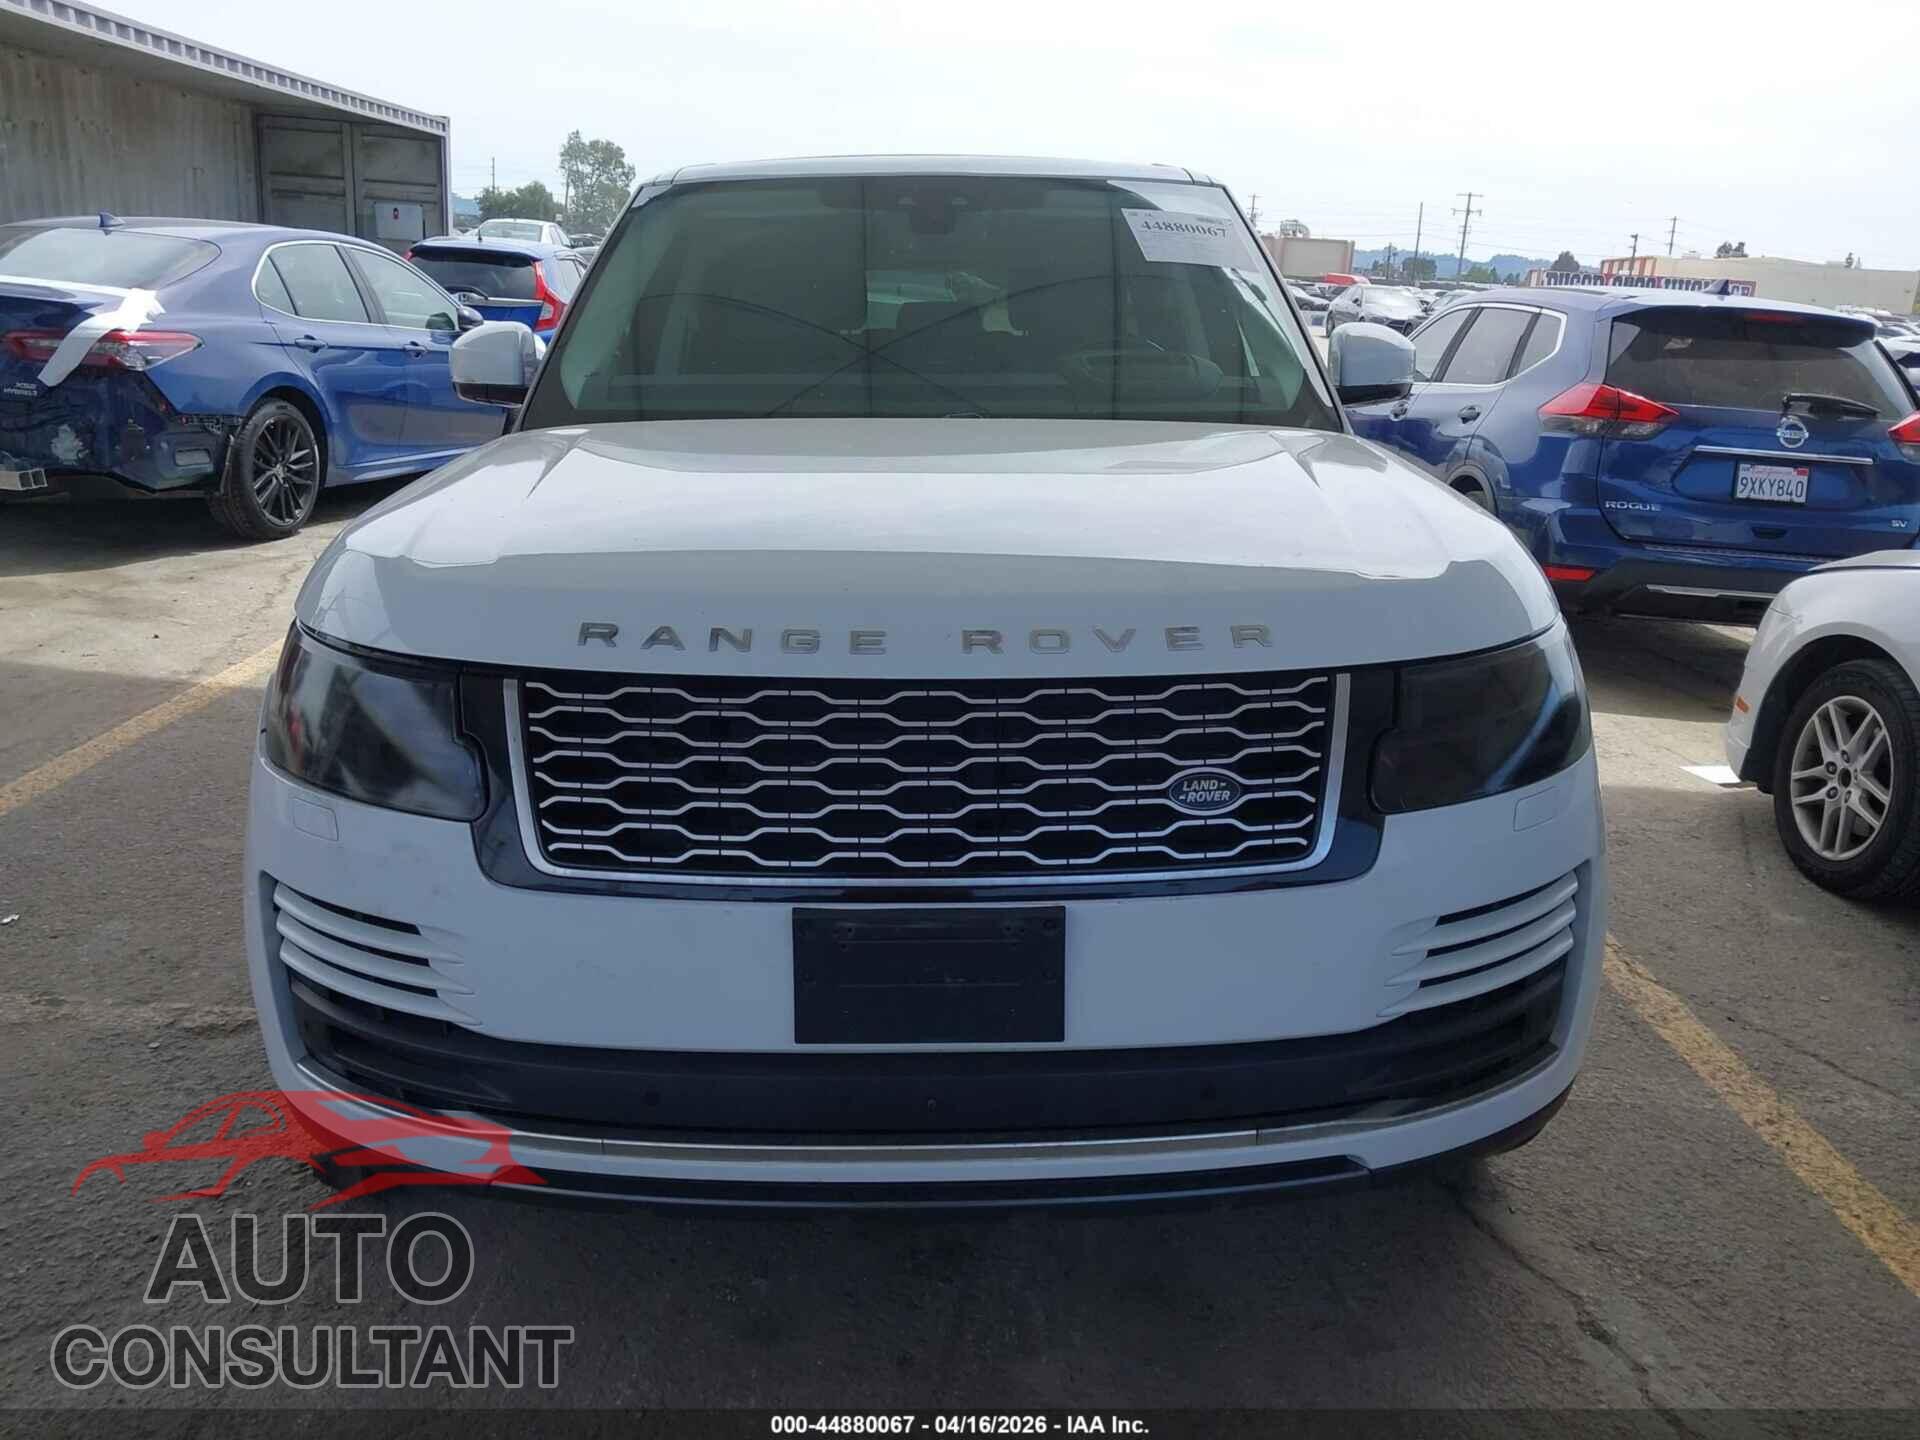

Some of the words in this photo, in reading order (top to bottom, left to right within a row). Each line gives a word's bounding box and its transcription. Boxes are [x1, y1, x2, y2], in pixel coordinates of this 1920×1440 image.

[1141, 220, 1227, 239] 44880067
[1739, 476, 1804, 498] 9XKY840
[577, 622, 887, 655] RANGE
[961, 624, 1273, 655] ROVER
[1182, 779, 1218, 792] LAND
[1186, 790, 1231, 803] ROVER
